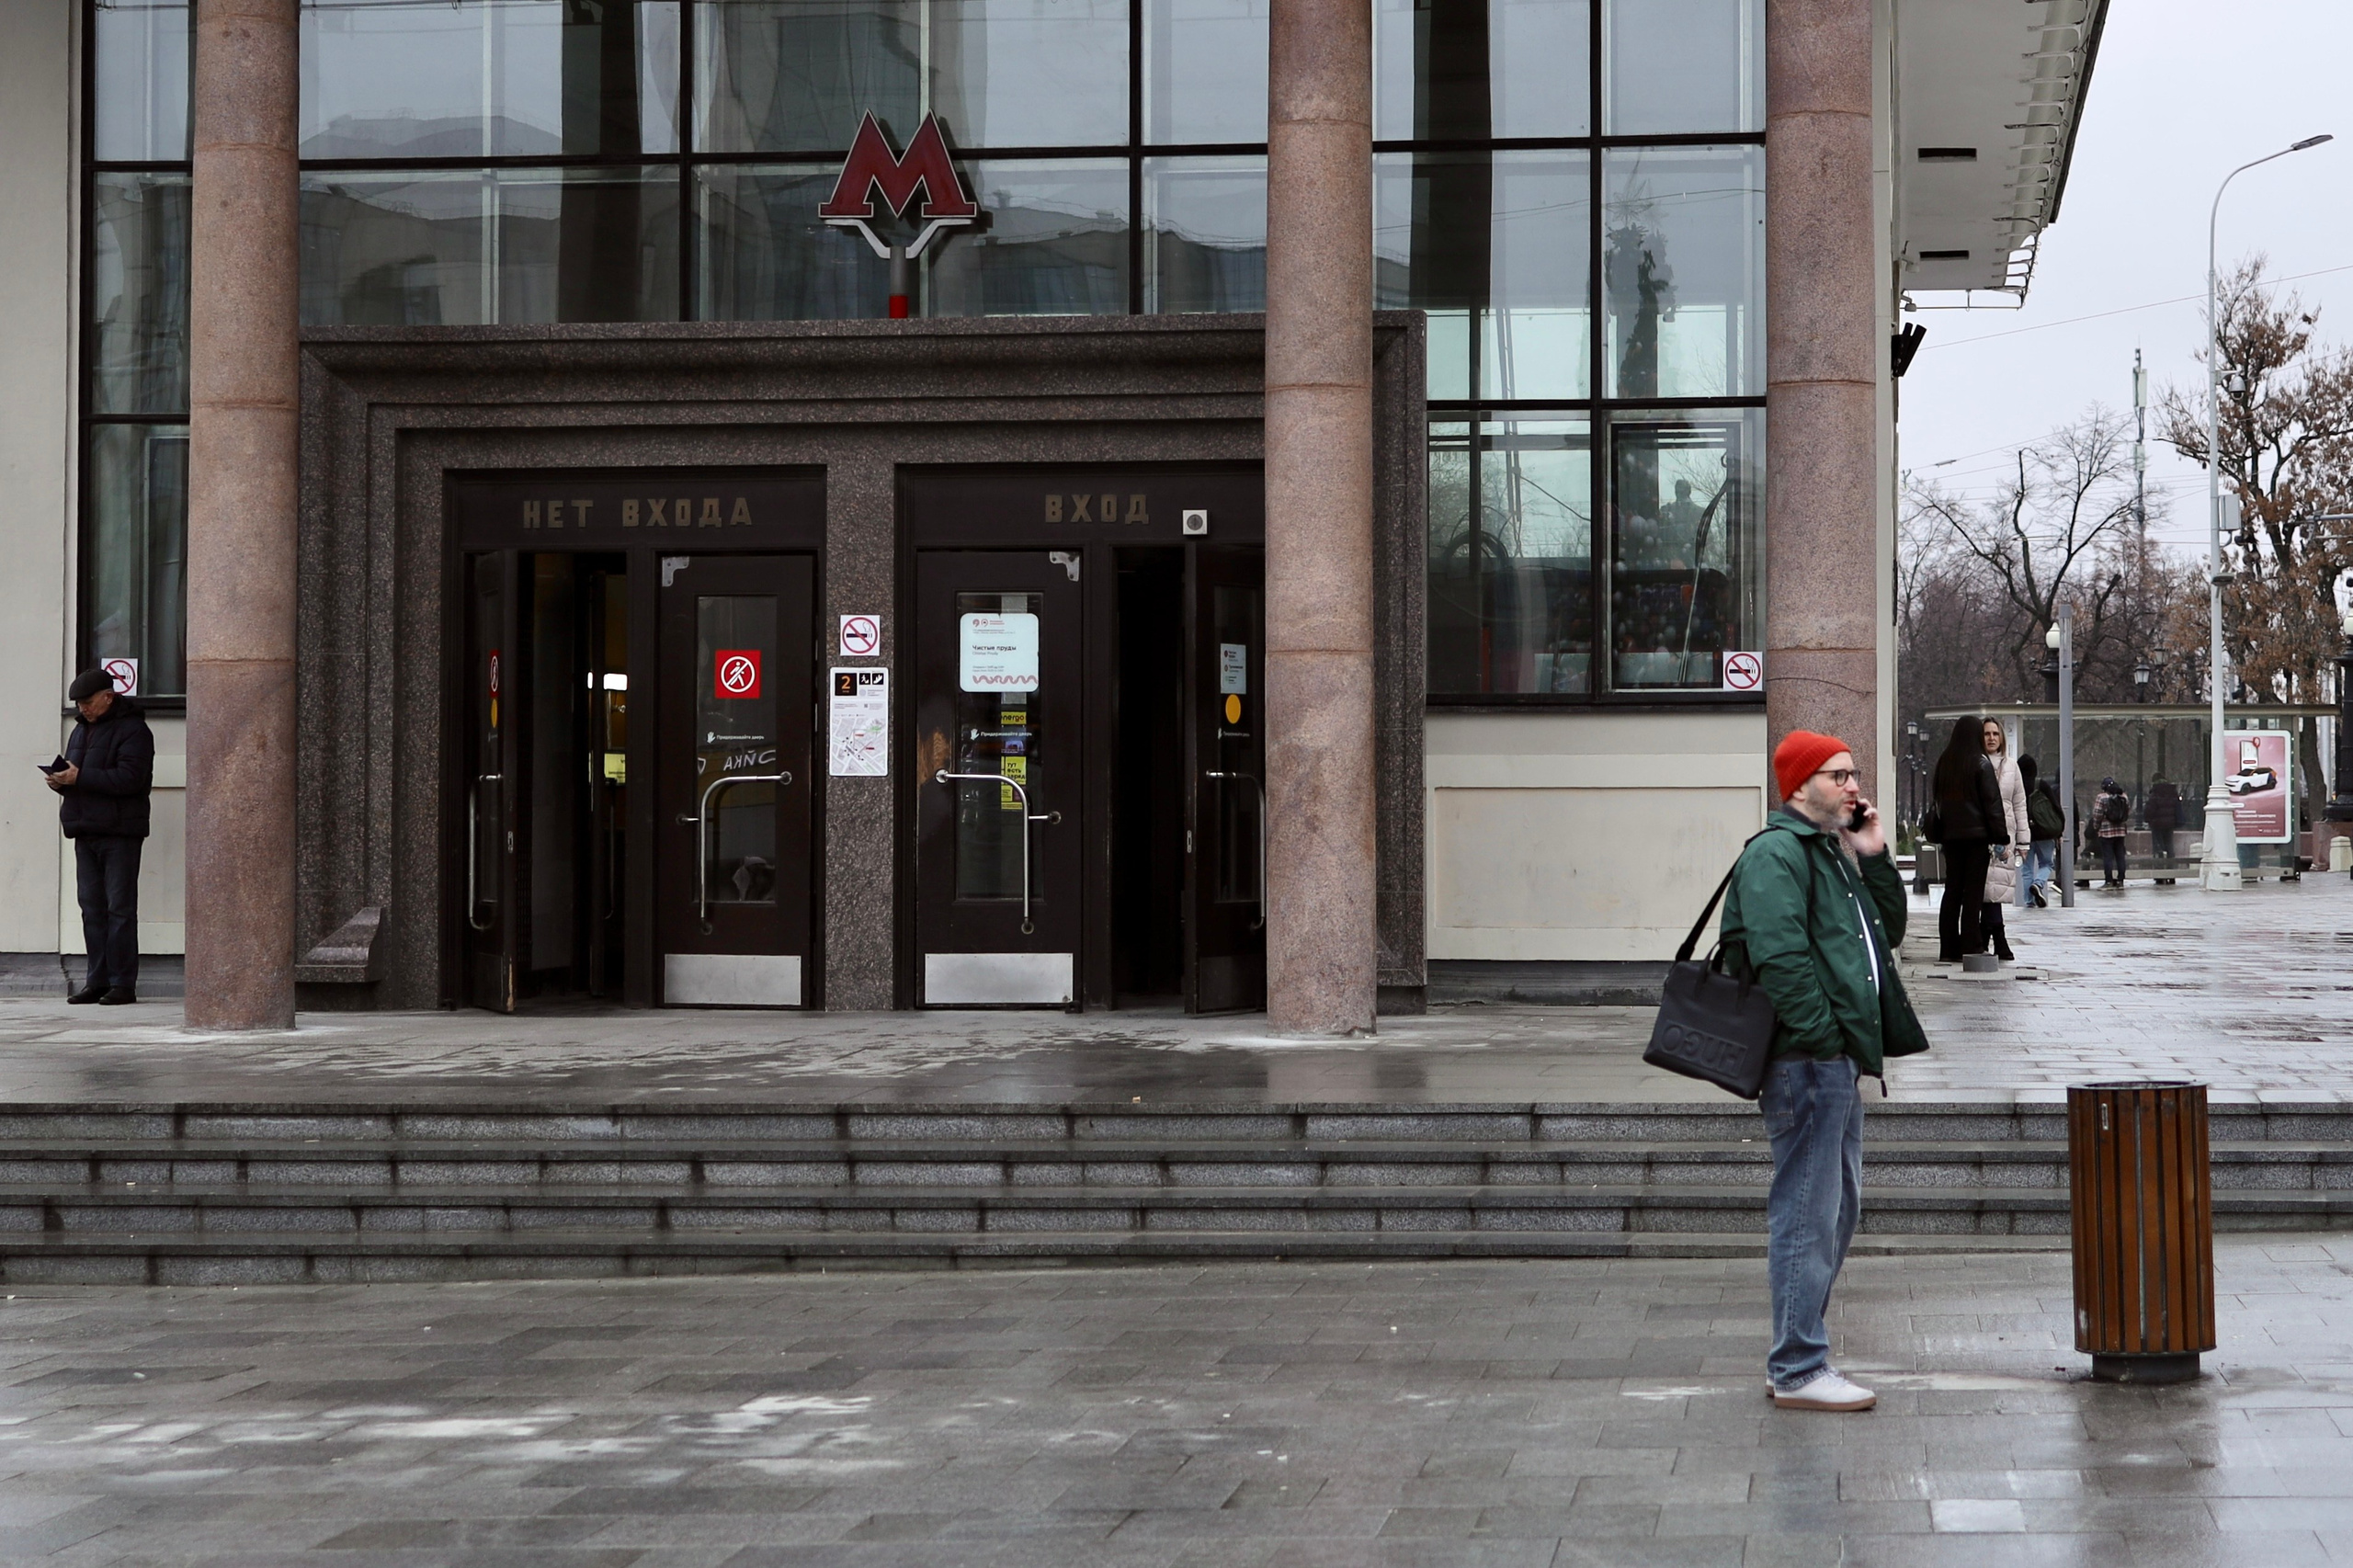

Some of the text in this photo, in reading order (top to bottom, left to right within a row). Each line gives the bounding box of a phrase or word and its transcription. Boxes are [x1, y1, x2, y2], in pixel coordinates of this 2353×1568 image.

[522, 496, 753, 530] НЕТ ВХОДА
[1044, 494, 1150, 526] ВХОД
[841, 675, 851, 689] 2
[1000, 713, 1025, 722] nergo
